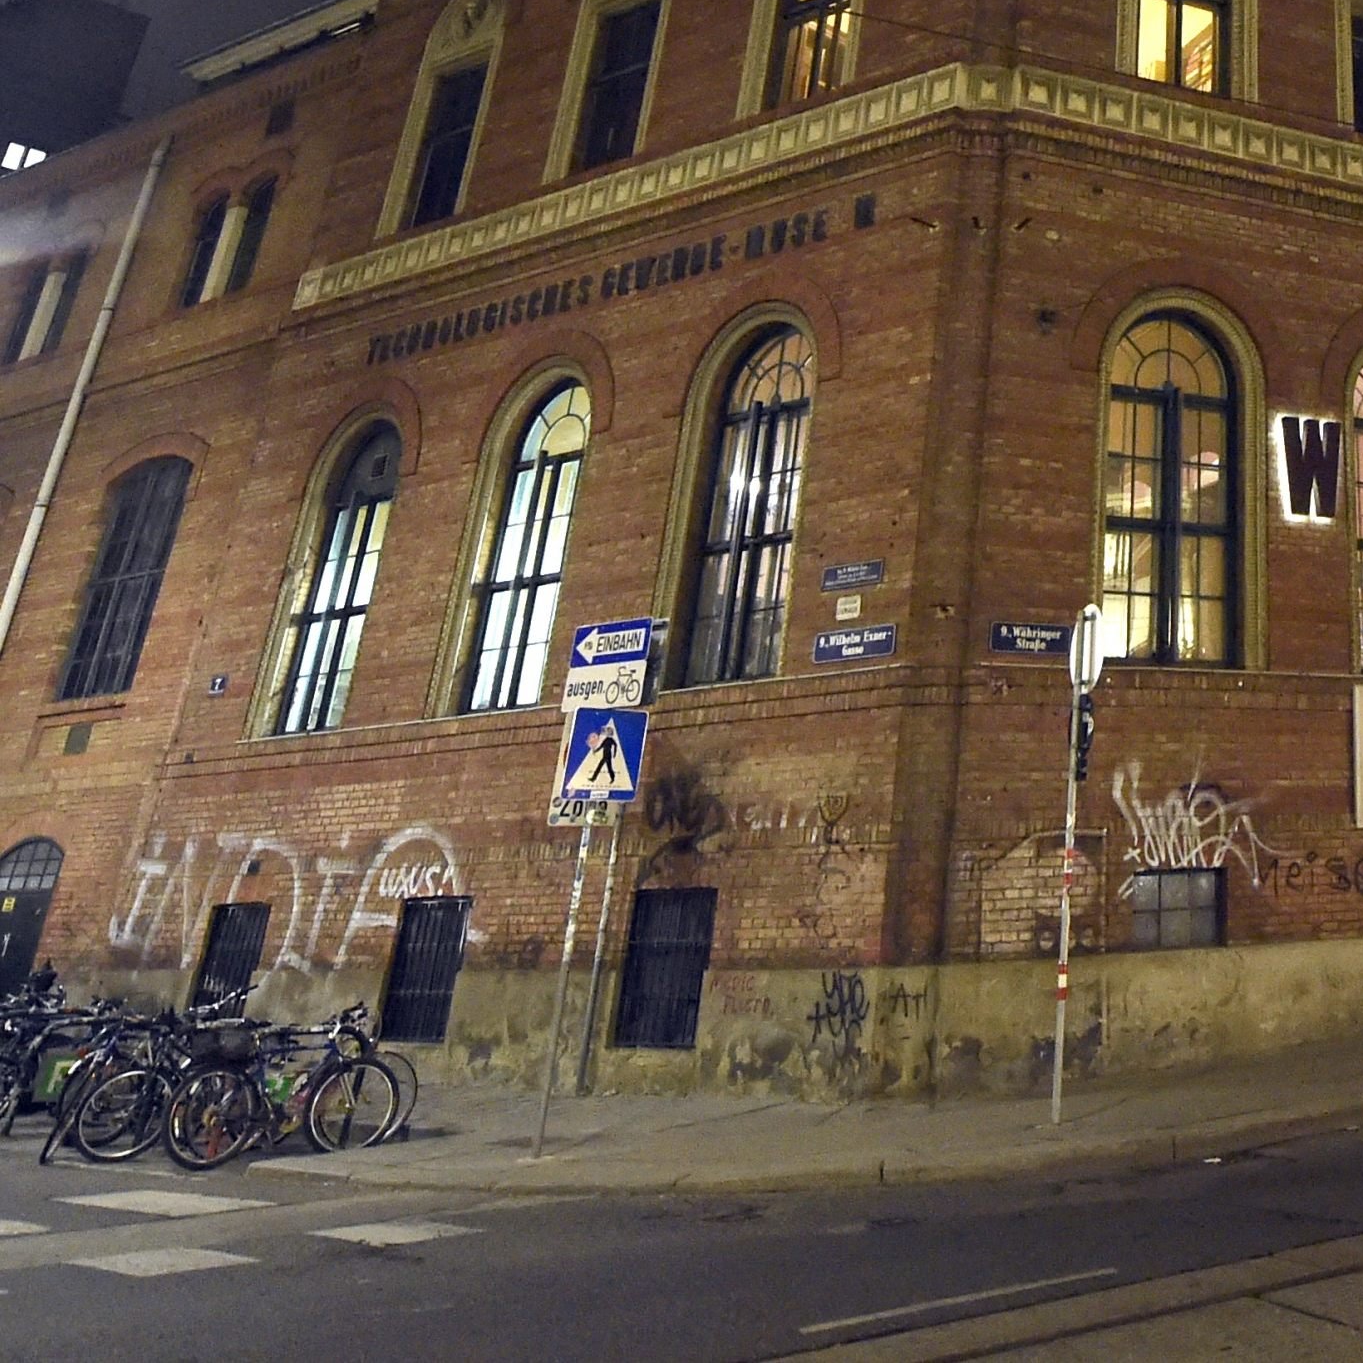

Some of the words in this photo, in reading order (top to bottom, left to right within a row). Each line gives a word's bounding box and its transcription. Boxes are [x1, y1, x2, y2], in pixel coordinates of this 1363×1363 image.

[596, 632, 642, 653] EINBAHN
[842, 645, 864, 656] Gasse
[1015, 637, 1046, 652] Straße
[567, 680, 606, 700] ausgen.
